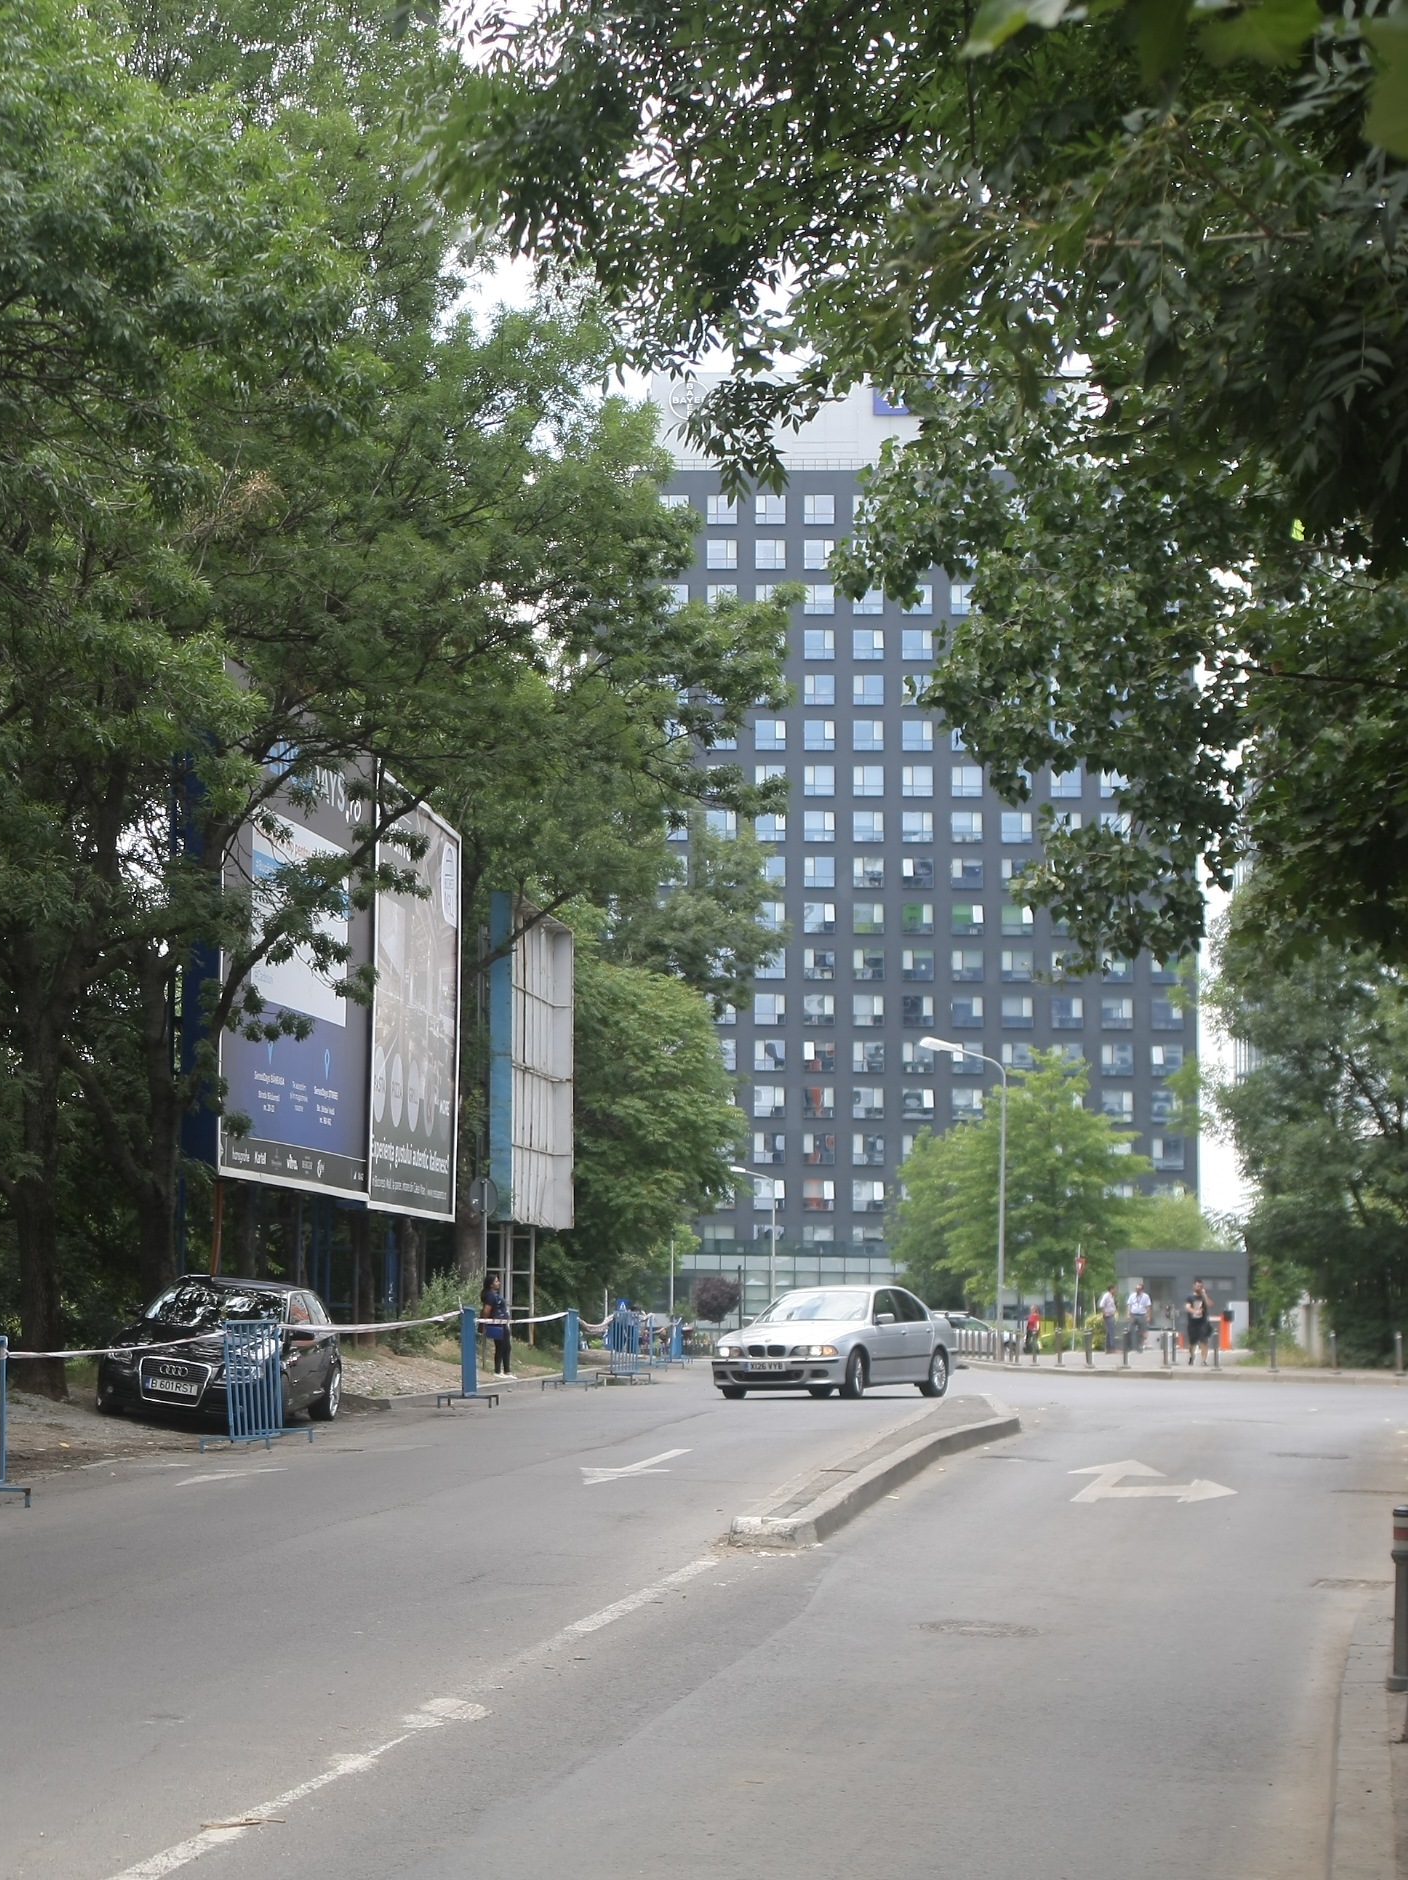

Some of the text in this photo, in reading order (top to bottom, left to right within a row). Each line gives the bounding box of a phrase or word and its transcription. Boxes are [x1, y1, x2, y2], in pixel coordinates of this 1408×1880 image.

[768, 1362, 783, 1370] VYB
[151, 1379, 194, 1393] B 601 RST
